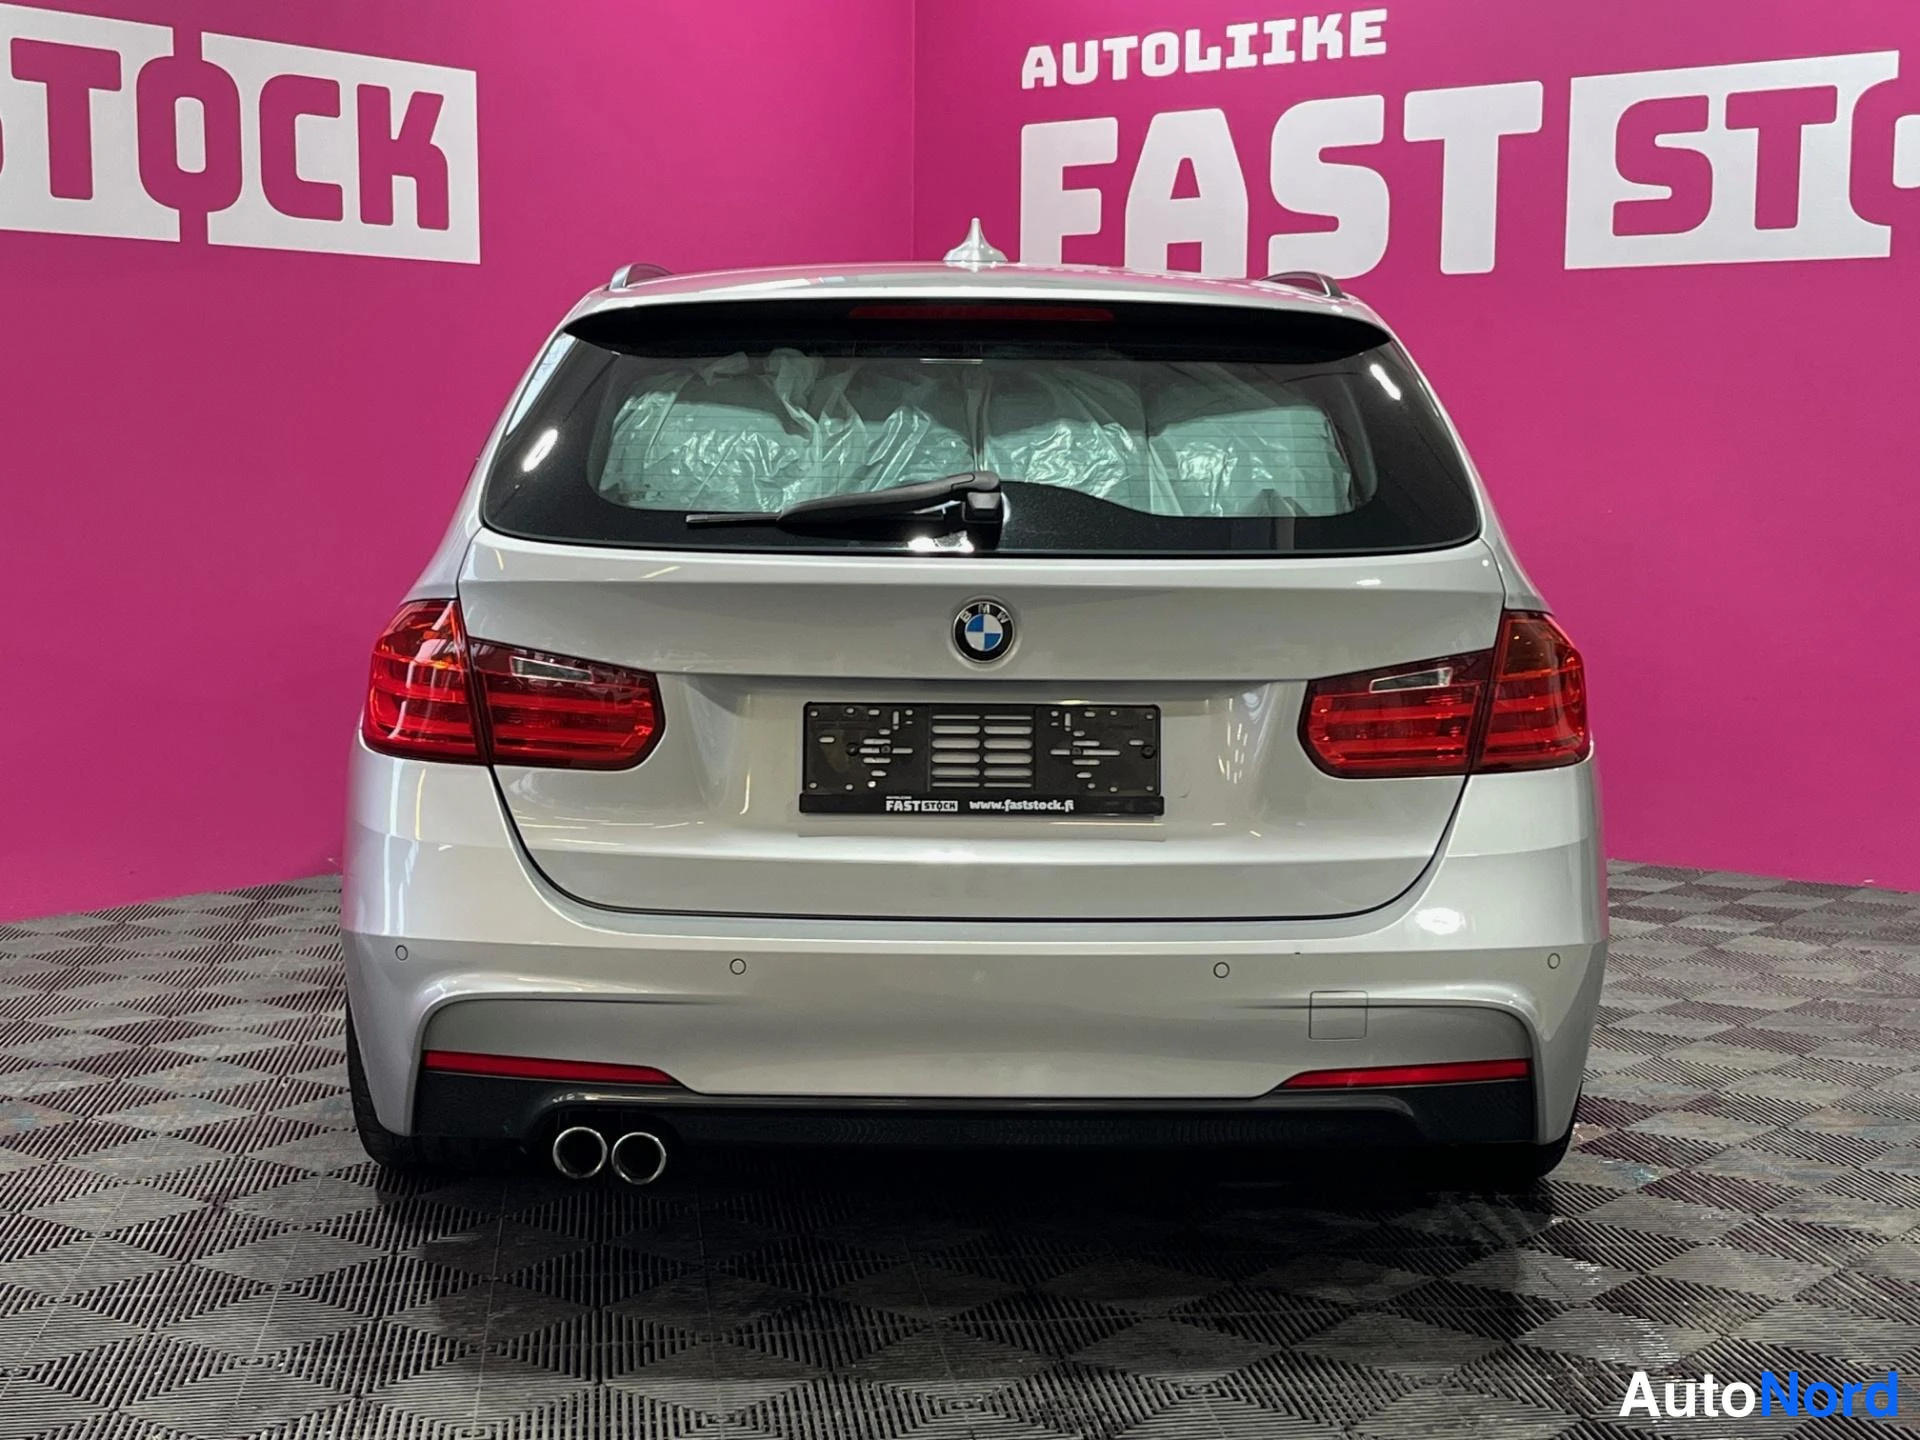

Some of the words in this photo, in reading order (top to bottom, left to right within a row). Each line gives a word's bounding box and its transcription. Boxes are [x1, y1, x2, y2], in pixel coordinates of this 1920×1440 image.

[1021, 8, 1388, 90] AUTOLIIKE
[0, 37, 449, 231] TOCK
[1020, 80, 1543, 280] FAST
[959, 603, 1010, 624] BMW
[969, 799, 1074, 813] www.faststock.fi
